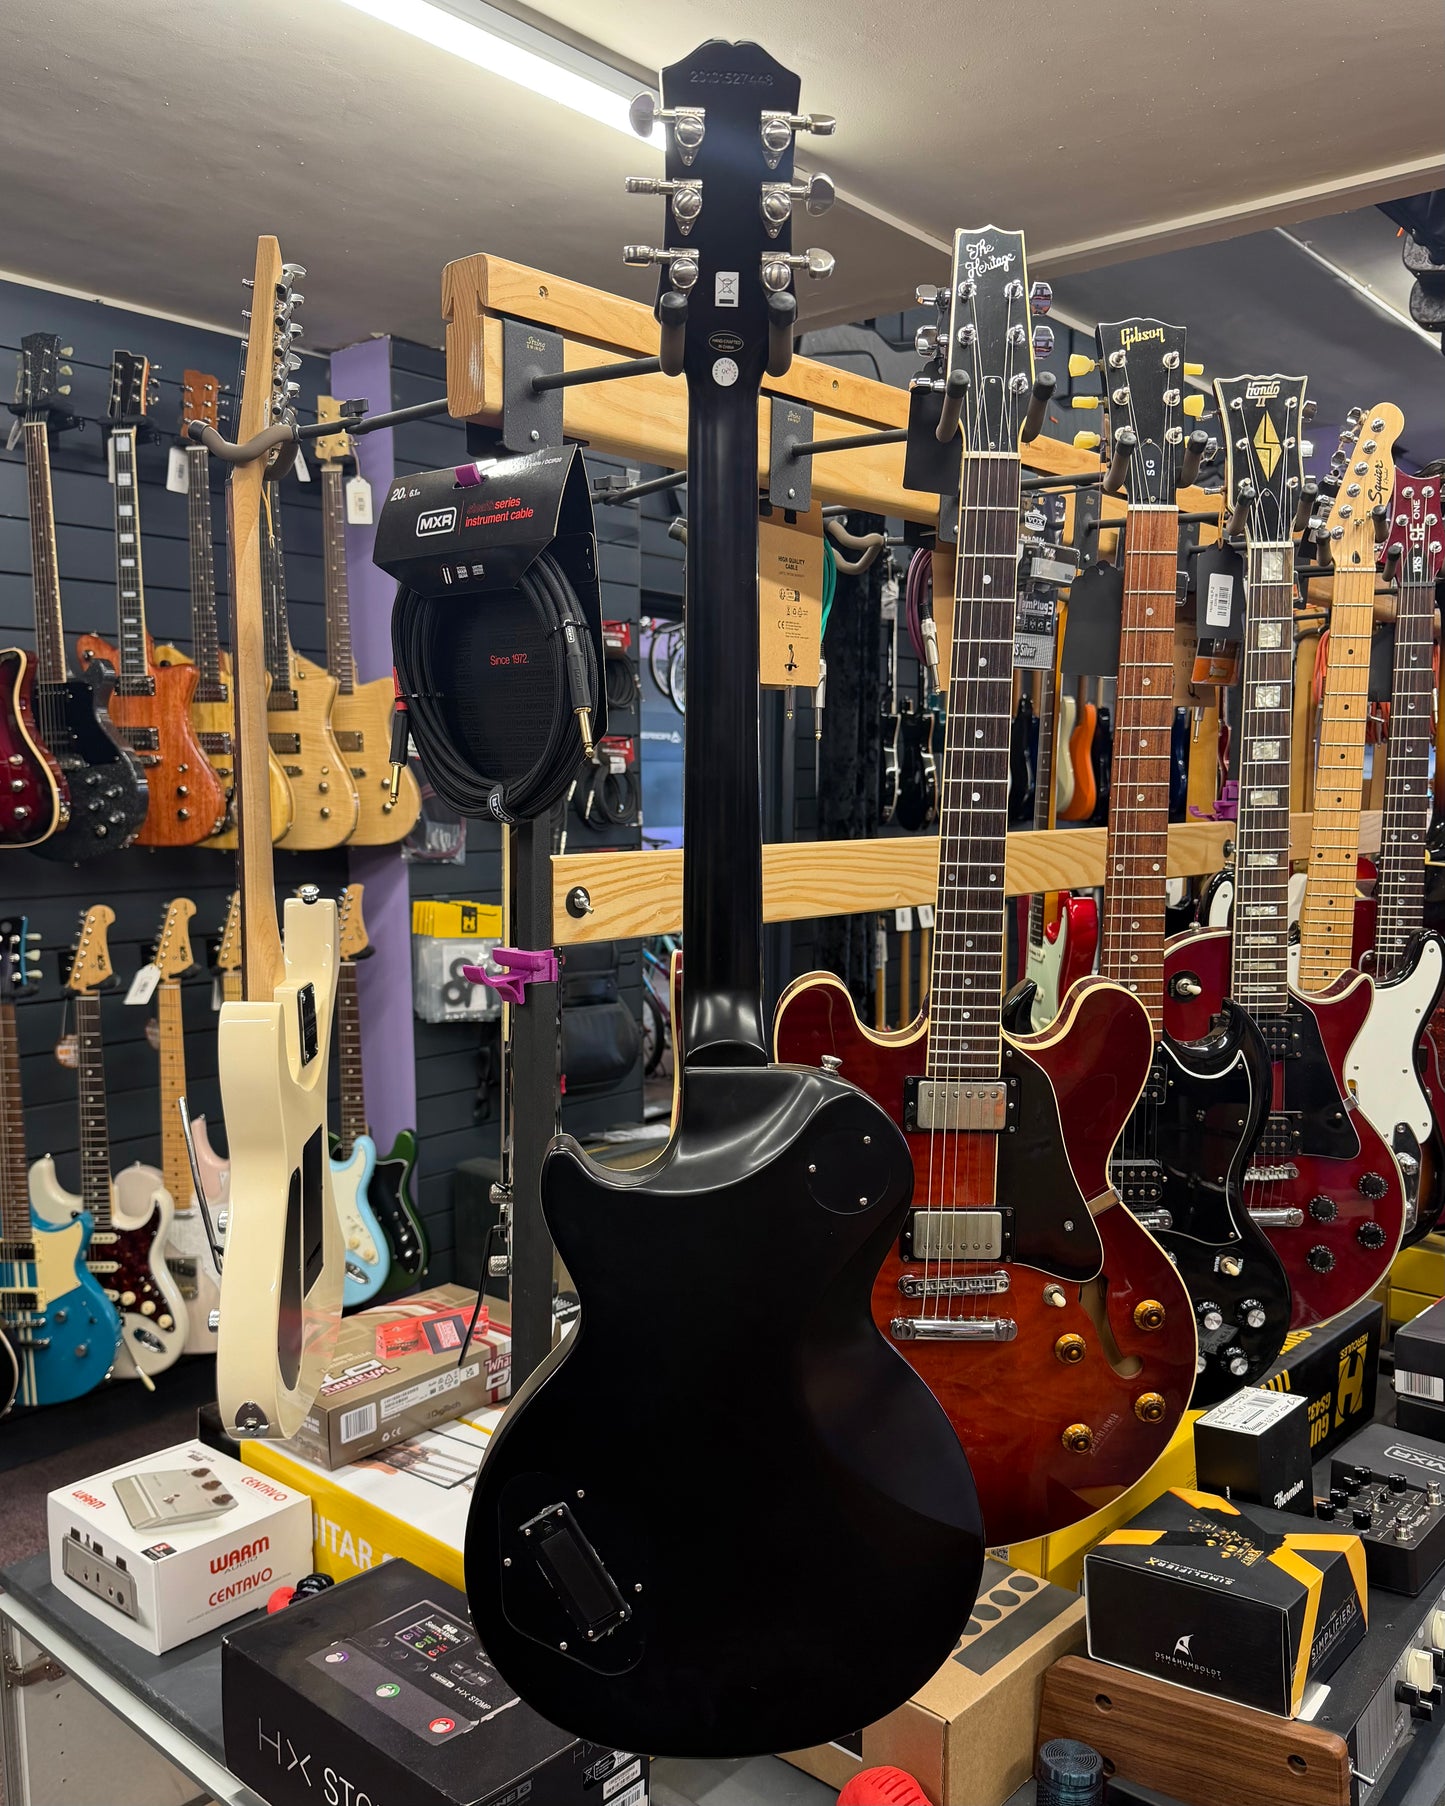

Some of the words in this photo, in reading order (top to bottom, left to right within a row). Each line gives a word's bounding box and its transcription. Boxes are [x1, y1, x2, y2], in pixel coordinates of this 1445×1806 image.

[966, 238, 995, 260] The
[965, 253, 1016, 279] Heritage
[1120, 326, 1166, 351] Gibson
[1246, 381, 1281, 398] Hondo
[1147, 459, 1156, 477] SG
[1367, 460, 1389, 504] Squier
[494, 497, 521, 511] series
[1412, 499, 1421, 520] ONE
[419, 513, 453, 532] MXR
[465, 512, 510, 528] instrument
[510, 508, 534, 521] cable
[1027, 516, 1044, 526] VOX
[785, 563, 798, 571] CABLE
[789, 557, 805, 566] QUALITY
[1412, 556, 1422, 573] PRS
[490, 655, 510, 666] Since
[1020, 644, 1036, 657] Silver
[1340, 1332, 1369, 1359] HERCULES
[431, 1401, 461, 1419] DigiTech
[1309, 1413, 1330, 1449] GUI
[71, 1489, 106, 1509] WARM
[241, 1476, 288, 1502] CENTAVO
[1273, 1479, 1304, 1509] Thermion
[209, 1535, 270, 1575] WARM
[223, 1555, 258, 1575] AUDIO
[208, 1566, 273, 1607] CENTAVO
[468, 1695, 492, 1710] STOMP
[258, 1717, 312, 1787] HX
